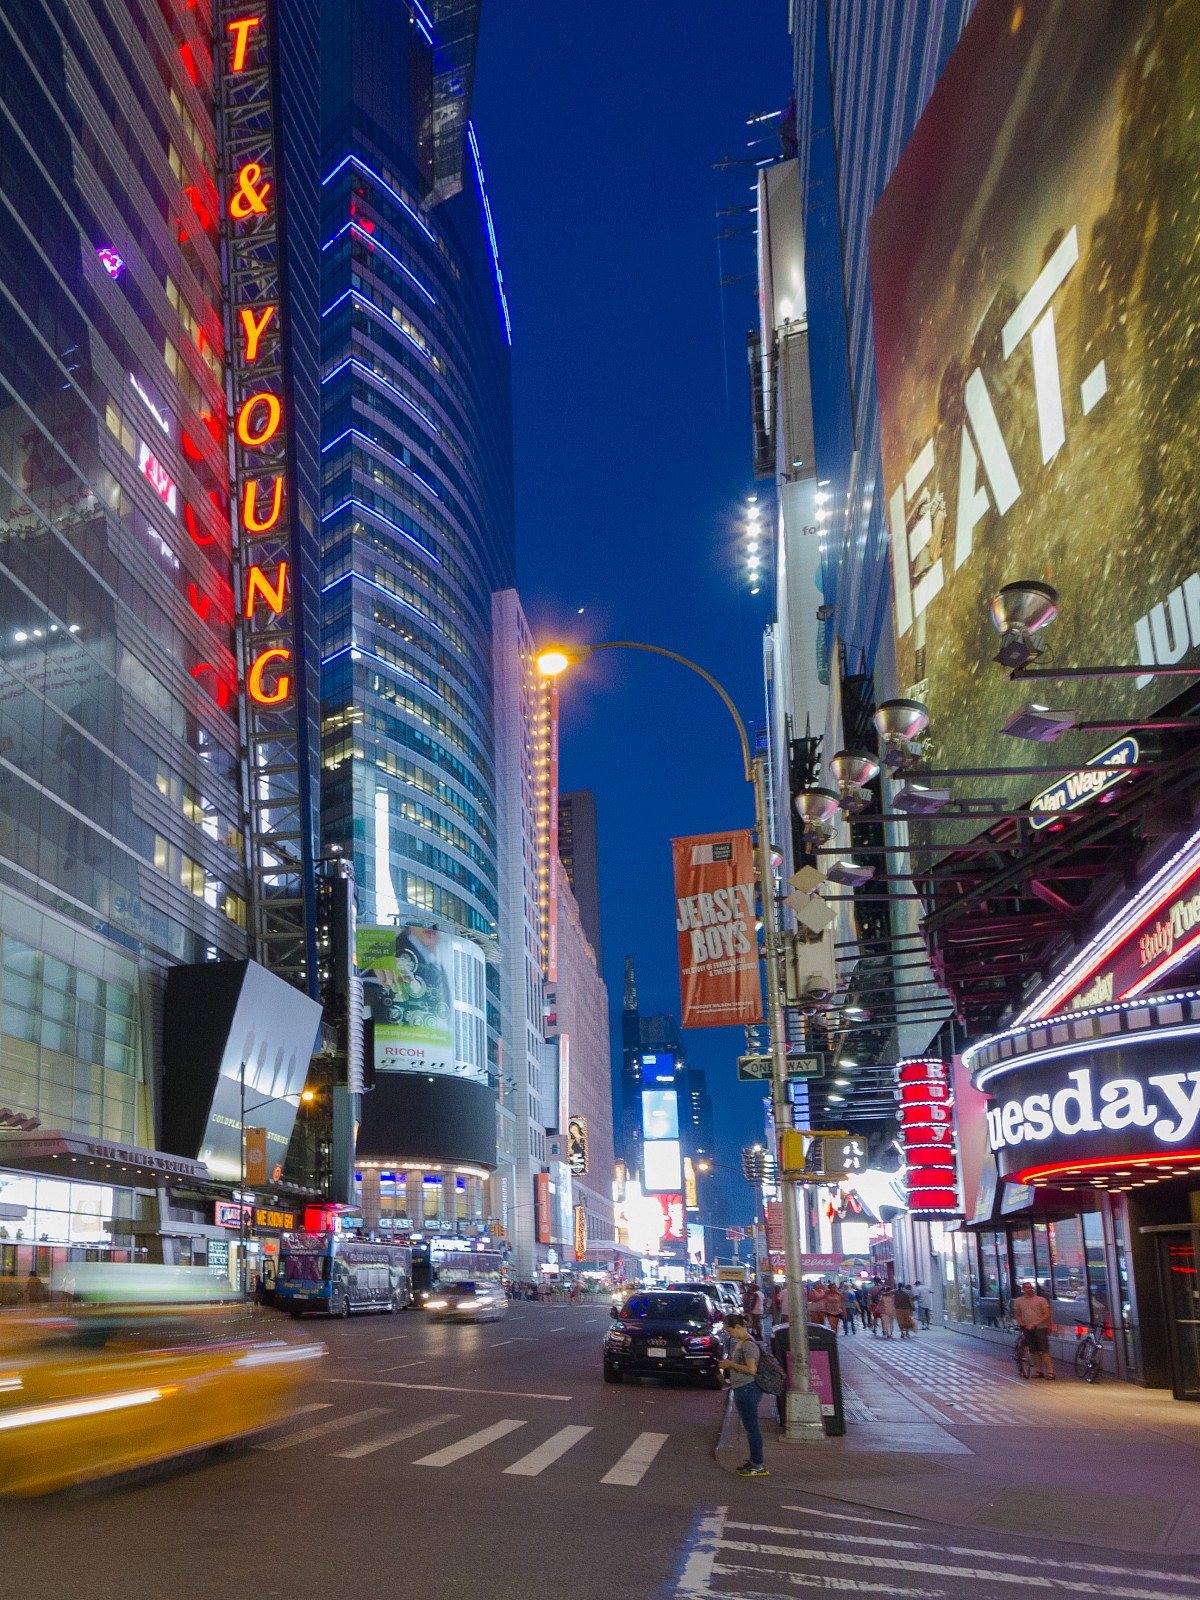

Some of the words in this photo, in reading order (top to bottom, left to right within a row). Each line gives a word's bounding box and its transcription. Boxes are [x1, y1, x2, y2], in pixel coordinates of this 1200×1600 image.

[228, 162, 272, 220] &
[889, 224, 1108, 639] EAT.
[237, 305, 291, 705] YOUNG
[1037, 789, 1066, 812] Van
[1066, 748, 1129, 801] Wagner
[676, 882, 756, 932] JERSEY
[690, 920, 751, 963] BOYS
[1139, 919, 1174, 968] Ruby
[385, 1047, 425, 1058] RICOH
[751, 1063, 773, 1073] ONE
[786, 1061, 811, 1071] WAY
[925, 1063, 946, 1141] Ruby
[267, 1131, 289, 1145] STORIES
